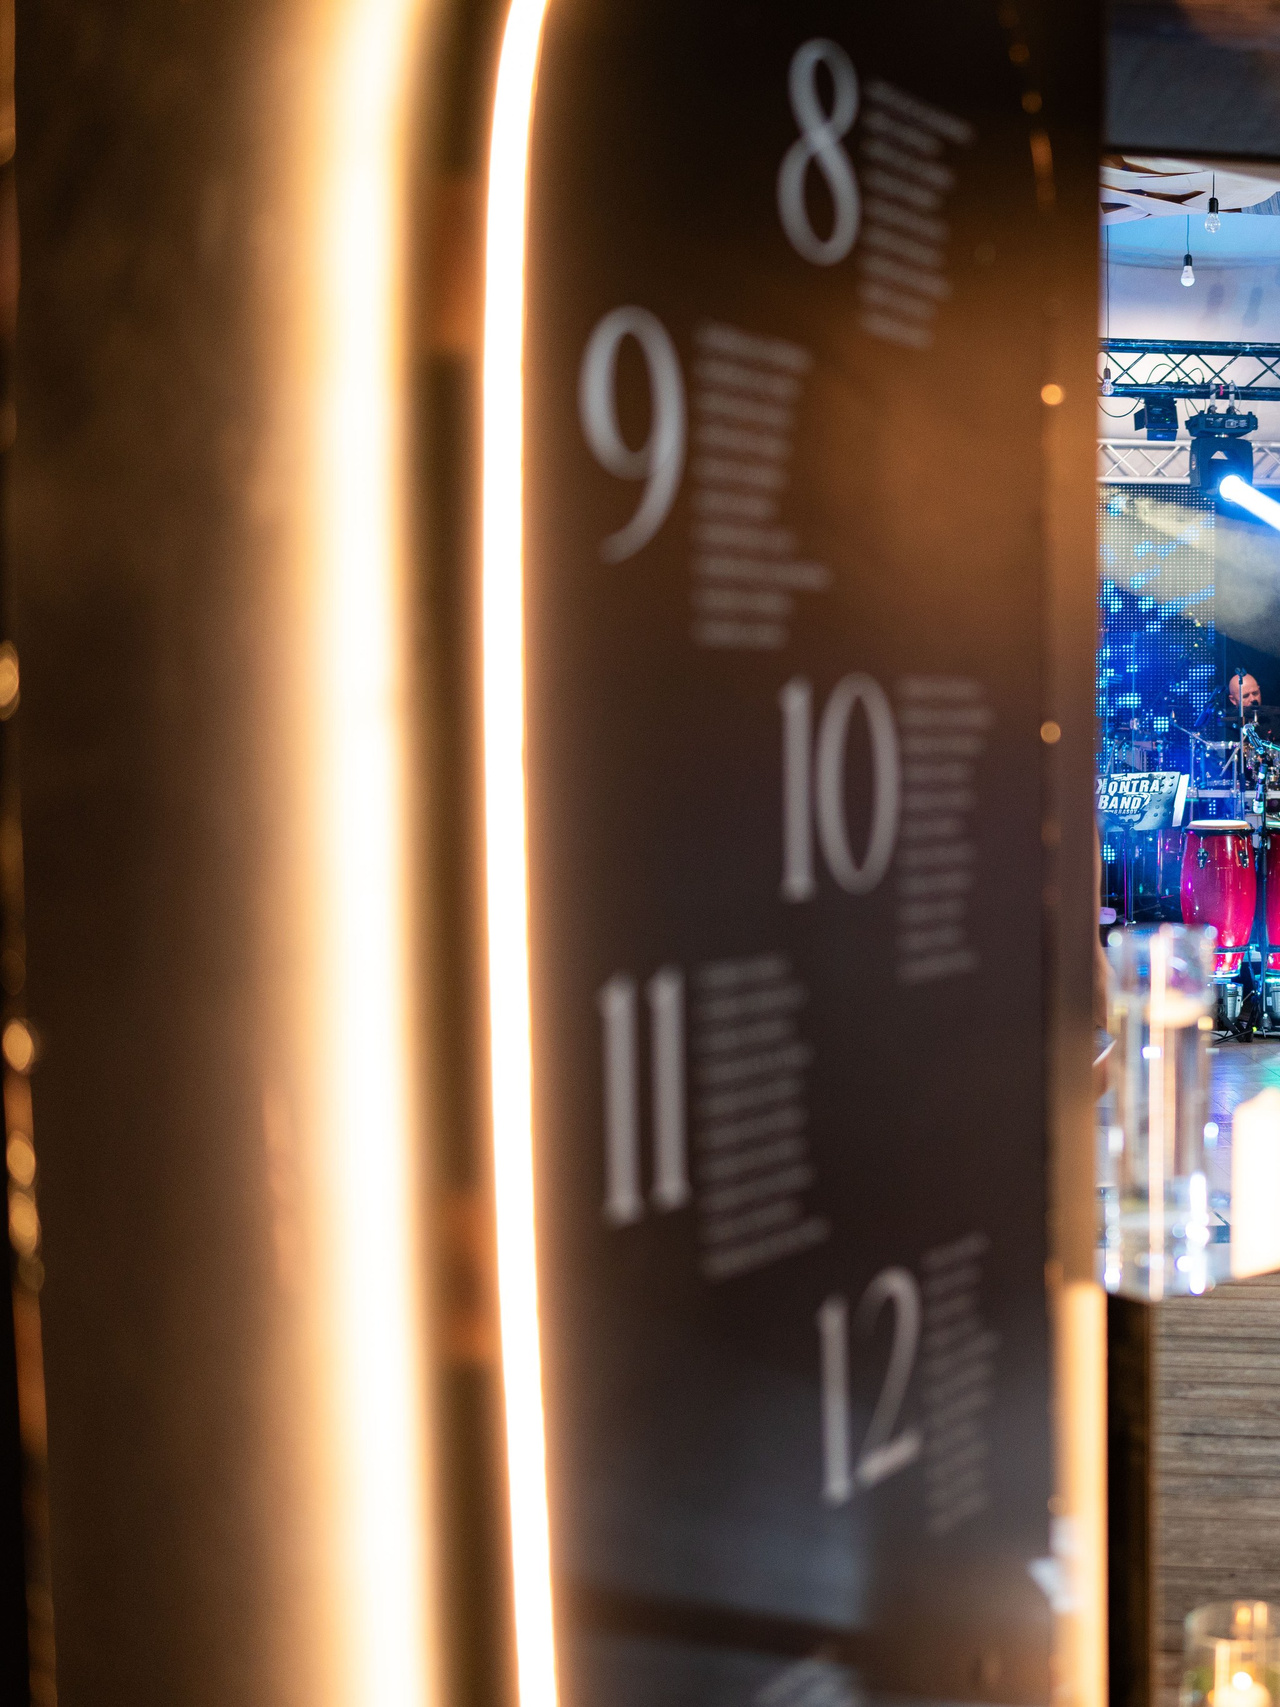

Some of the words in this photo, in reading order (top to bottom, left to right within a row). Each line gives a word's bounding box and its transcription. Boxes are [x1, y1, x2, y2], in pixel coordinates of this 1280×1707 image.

[777, 37, 861, 267] 8
[579, 304, 687, 565] 9
[778, 672, 899, 902] 10
[1097, 794, 1142, 810] BAND
[598, 963, 692, 1228] 11
[818, 1266, 922, 1508] 12
